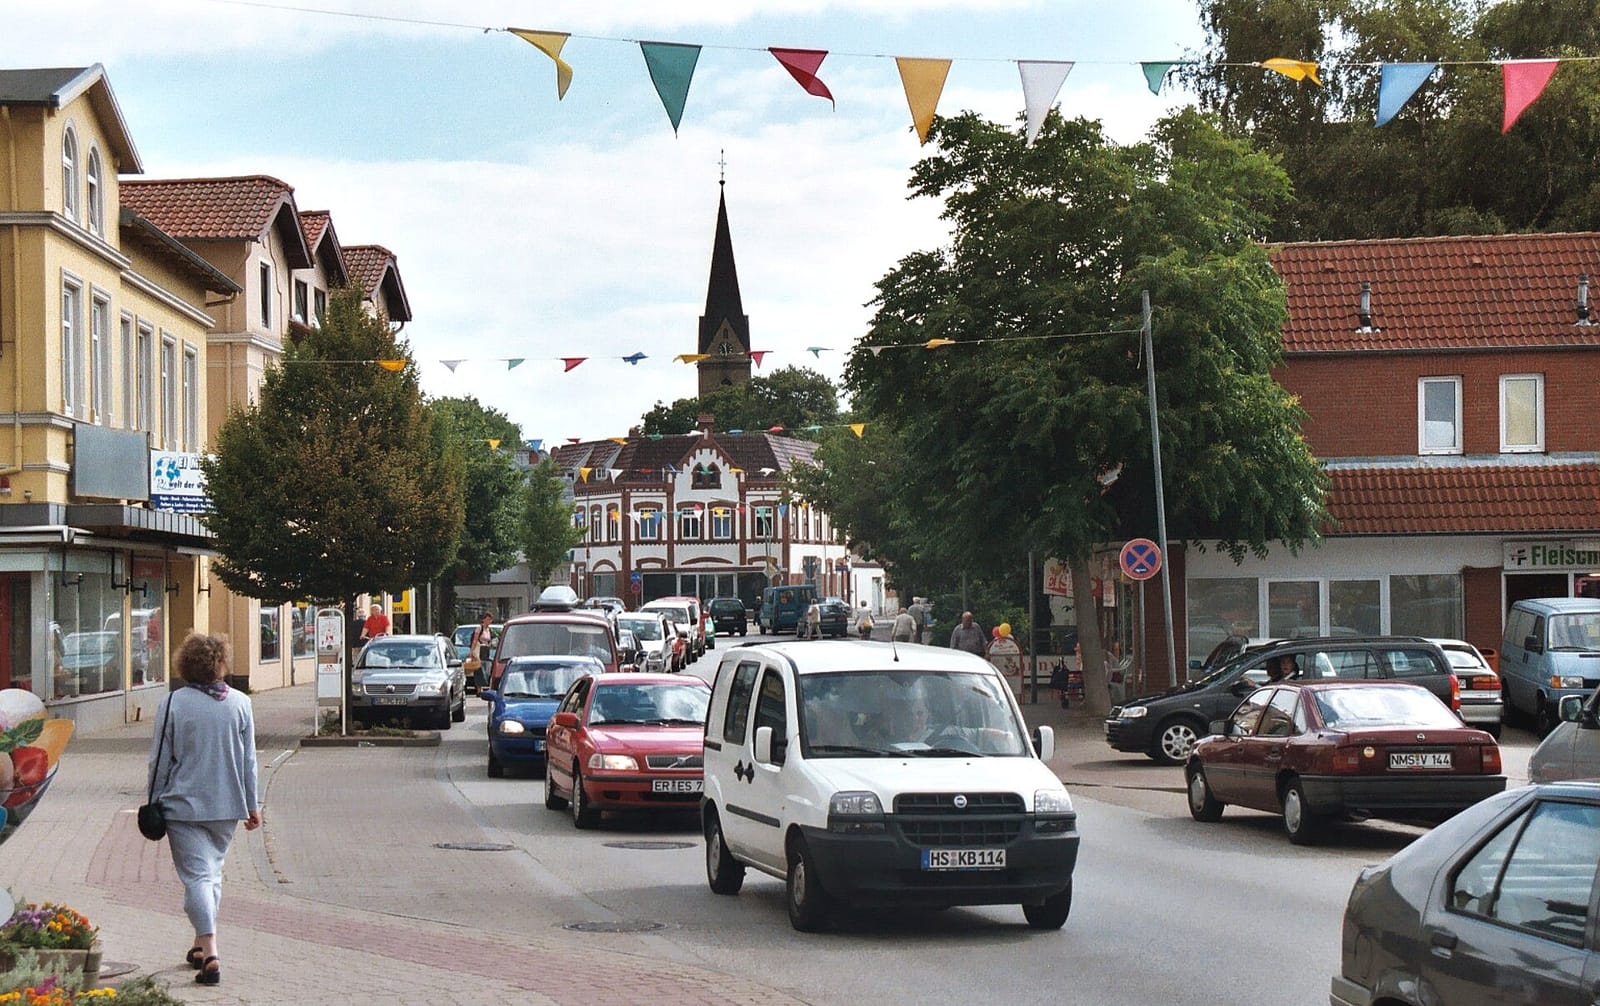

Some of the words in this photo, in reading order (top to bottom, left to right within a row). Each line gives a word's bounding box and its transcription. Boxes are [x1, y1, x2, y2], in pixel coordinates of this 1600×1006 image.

[184, 480, 194, 489] der
[1531, 544, 1600, 566] Fleisch
[1391, 754, 1416, 765] NMS
[1420, 754, 1428, 765] V
[1432, 753, 1450, 765] 144
[654, 781, 670, 791] ER
[677, 781, 692, 791] ES
[930, 851, 950, 866] HS
